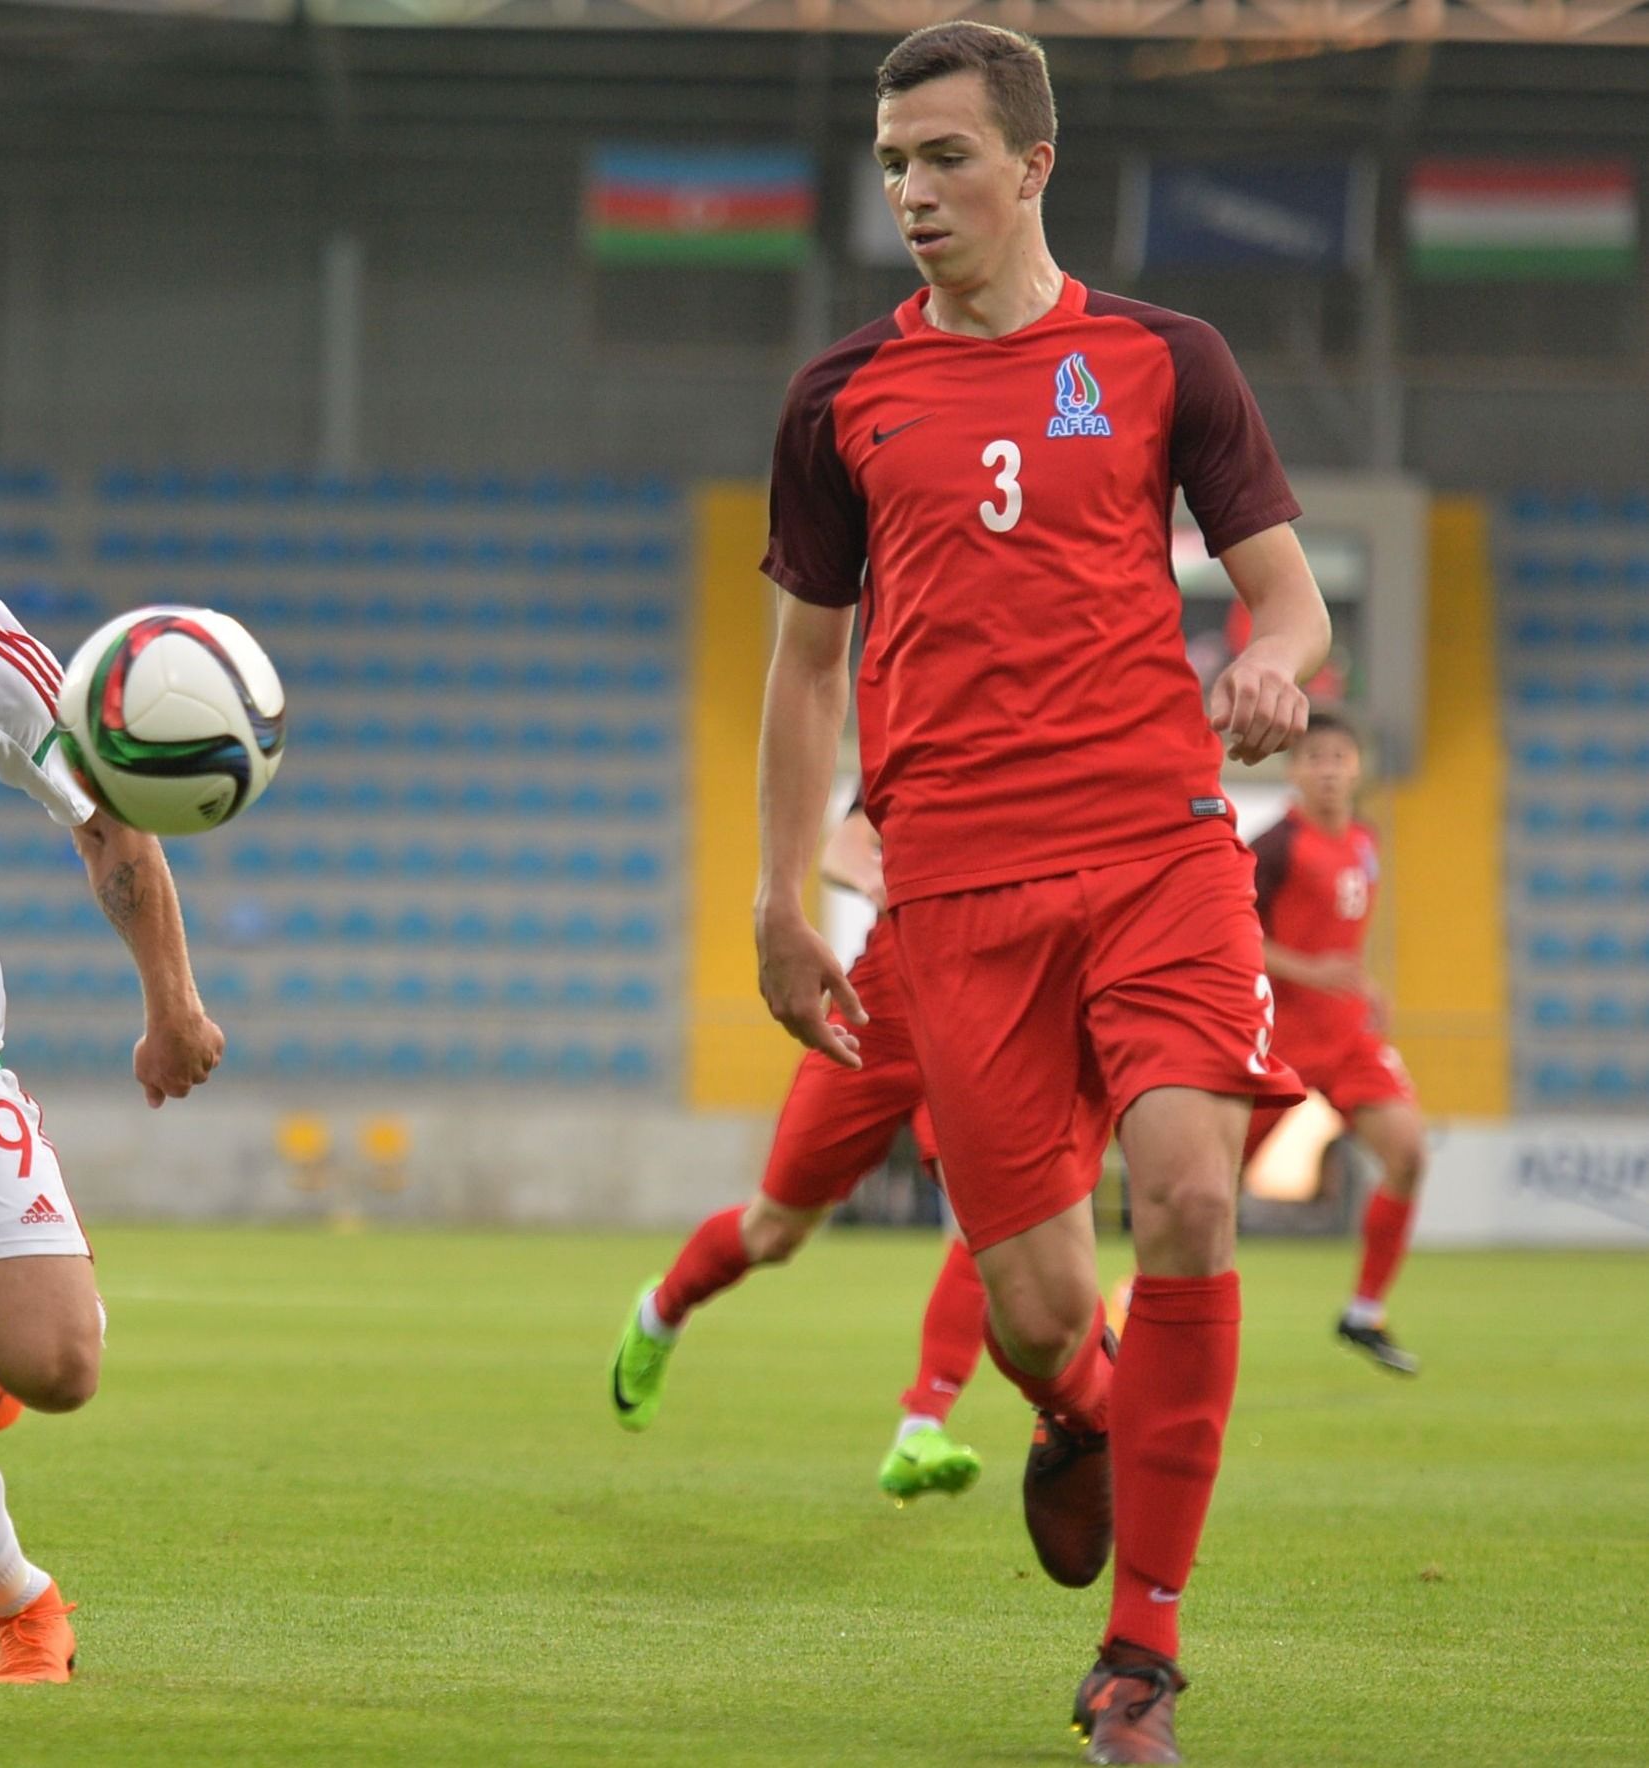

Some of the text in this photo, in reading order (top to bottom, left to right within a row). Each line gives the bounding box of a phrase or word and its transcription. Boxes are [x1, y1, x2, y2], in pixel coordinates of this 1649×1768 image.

[1049, 416, 1110, 436] AFFA
[979, 439, 1022, 533] 3
[20, 1211, 65, 1224] adidas
